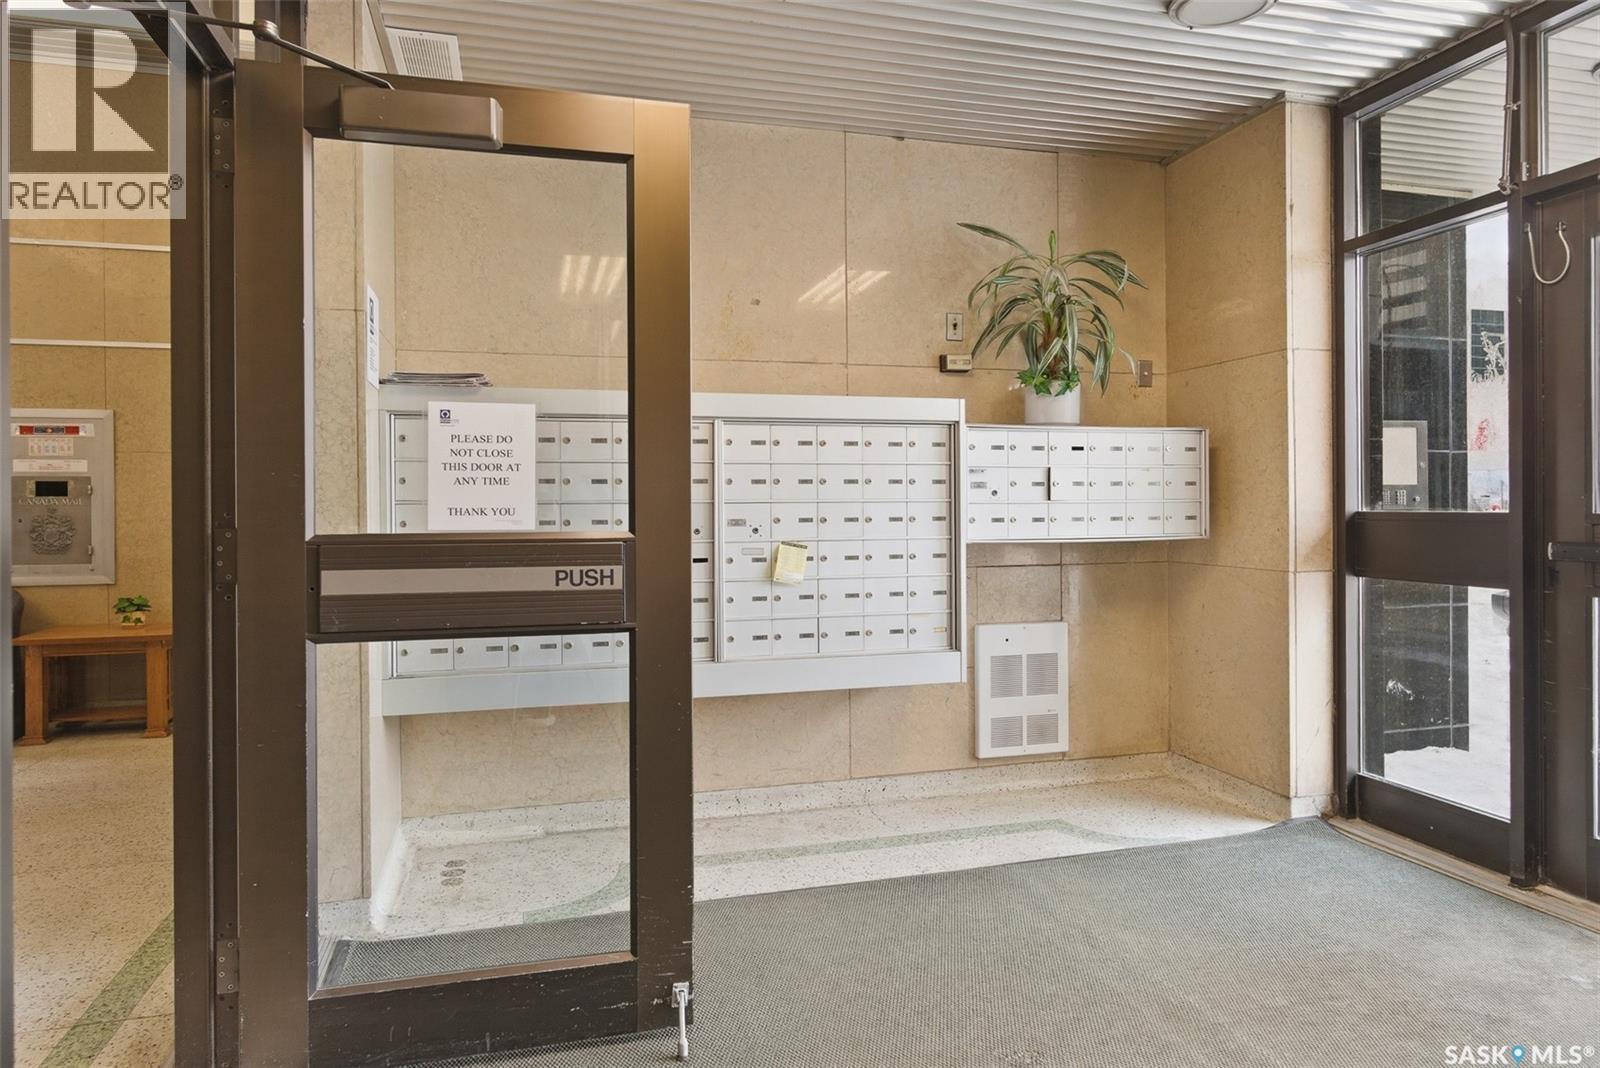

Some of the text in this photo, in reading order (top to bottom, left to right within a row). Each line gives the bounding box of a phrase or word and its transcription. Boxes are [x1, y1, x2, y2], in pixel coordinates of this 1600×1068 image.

[450, 434, 513, 444] PLEASE DO
[449, 448, 514, 458] NOT CLOSE
[441, 462, 521, 472] THIS DOOR AT
[453, 476, 510, 486] ANY TIME
[447, 507, 516, 517] THANK YOU
[555, 568, 614, 587] PUSH
